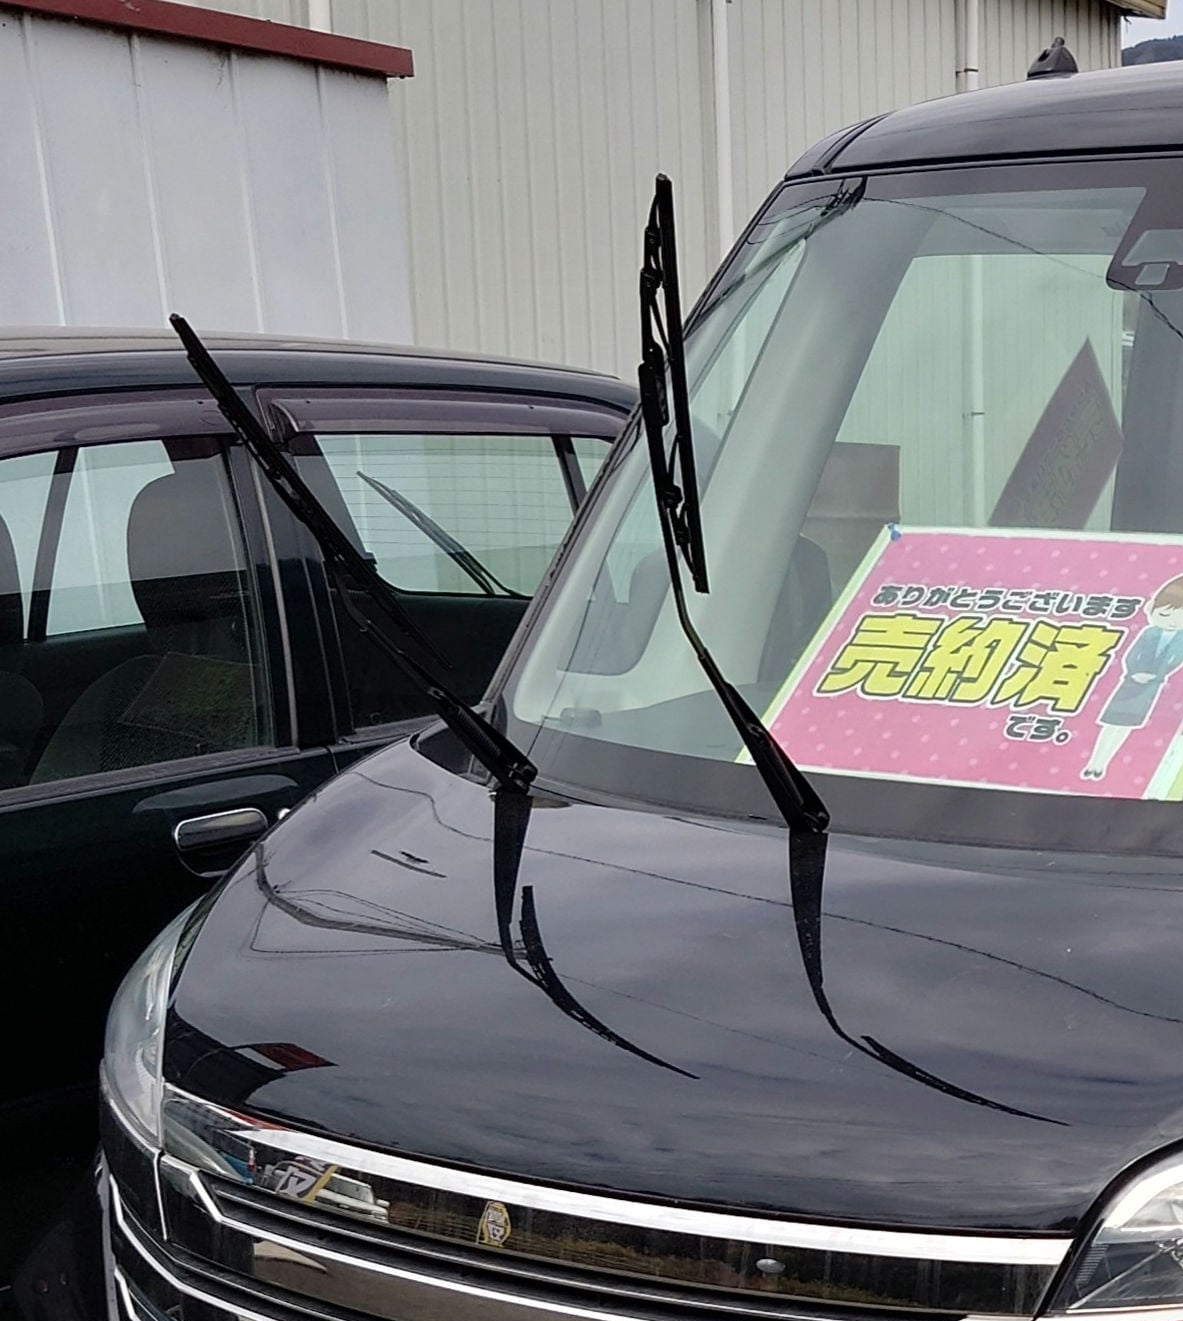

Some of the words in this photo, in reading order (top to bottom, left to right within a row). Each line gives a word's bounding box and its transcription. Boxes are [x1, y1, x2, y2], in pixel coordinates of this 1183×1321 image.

[872, 584, 1142, 618] ありがとうございます
[815, 612, 1127, 713] 売約済
[1006, 715, 1070, 743] です。
